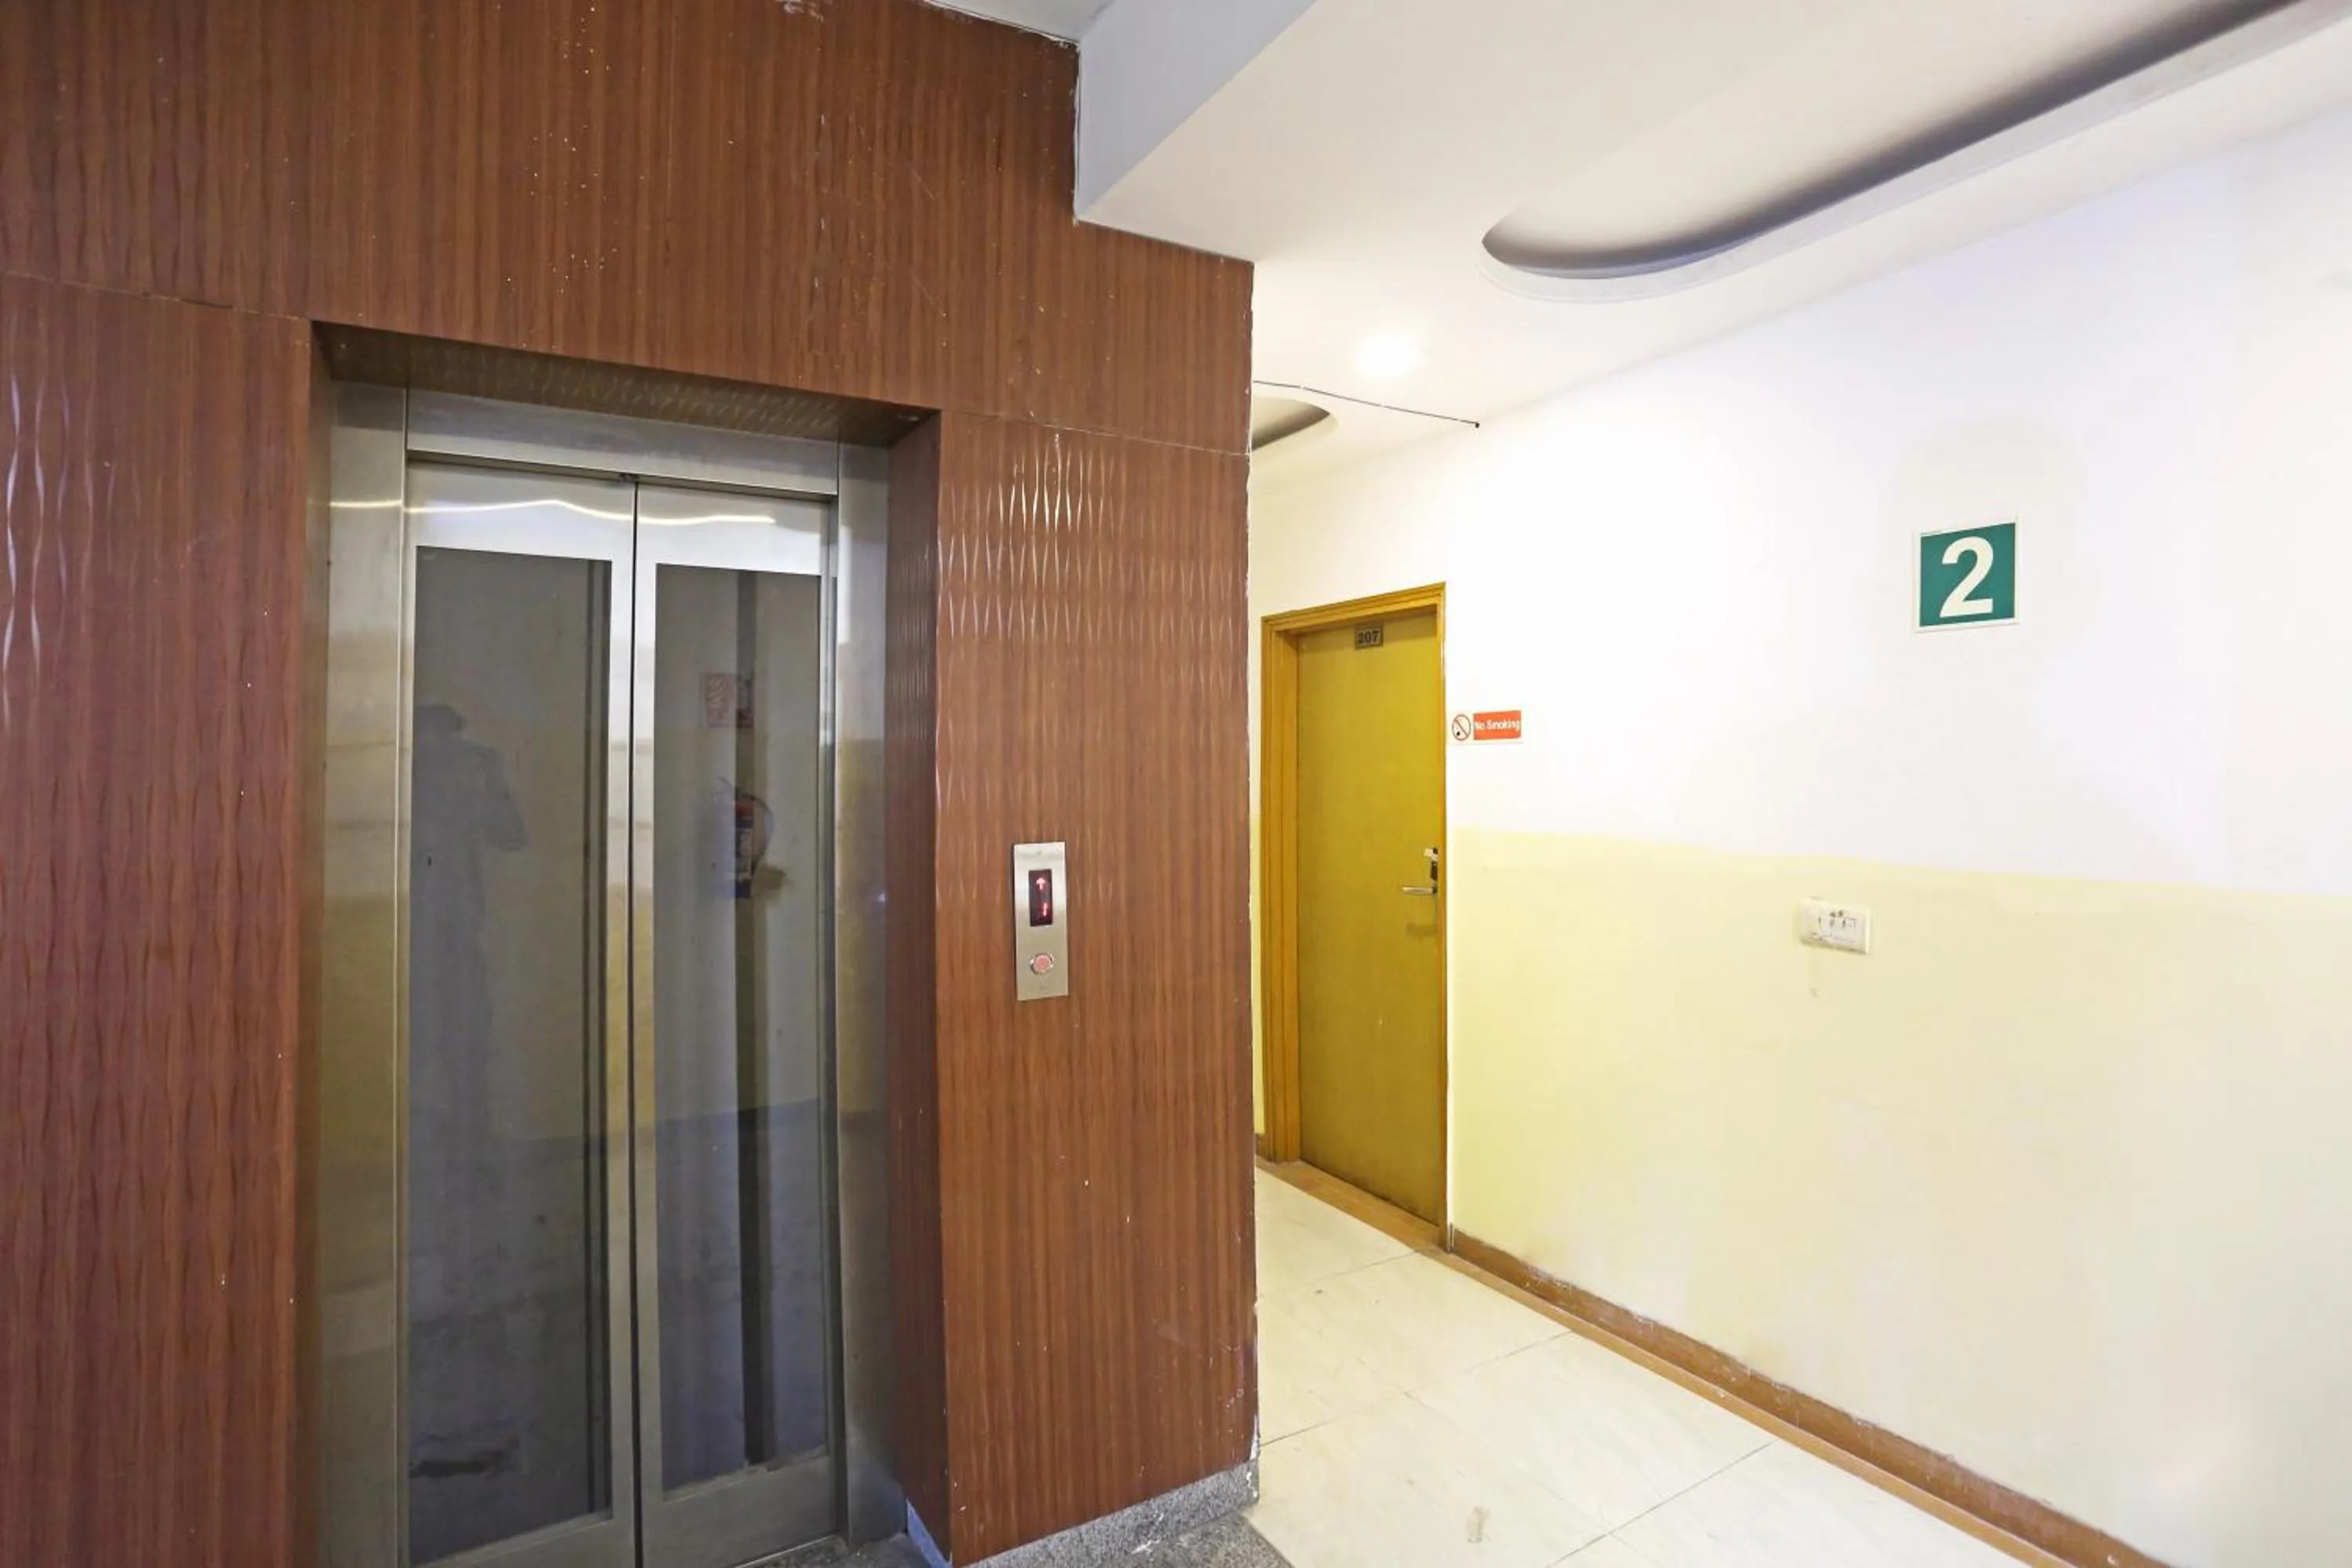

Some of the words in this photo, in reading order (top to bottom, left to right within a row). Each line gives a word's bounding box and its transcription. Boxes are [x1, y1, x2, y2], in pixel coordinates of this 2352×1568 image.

[1940, 536, 1993, 618] 2
[1357, 630, 1380, 644] 207
[1475, 720, 1485, 730] No
[1486, 718, 1519, 731] Smoking
